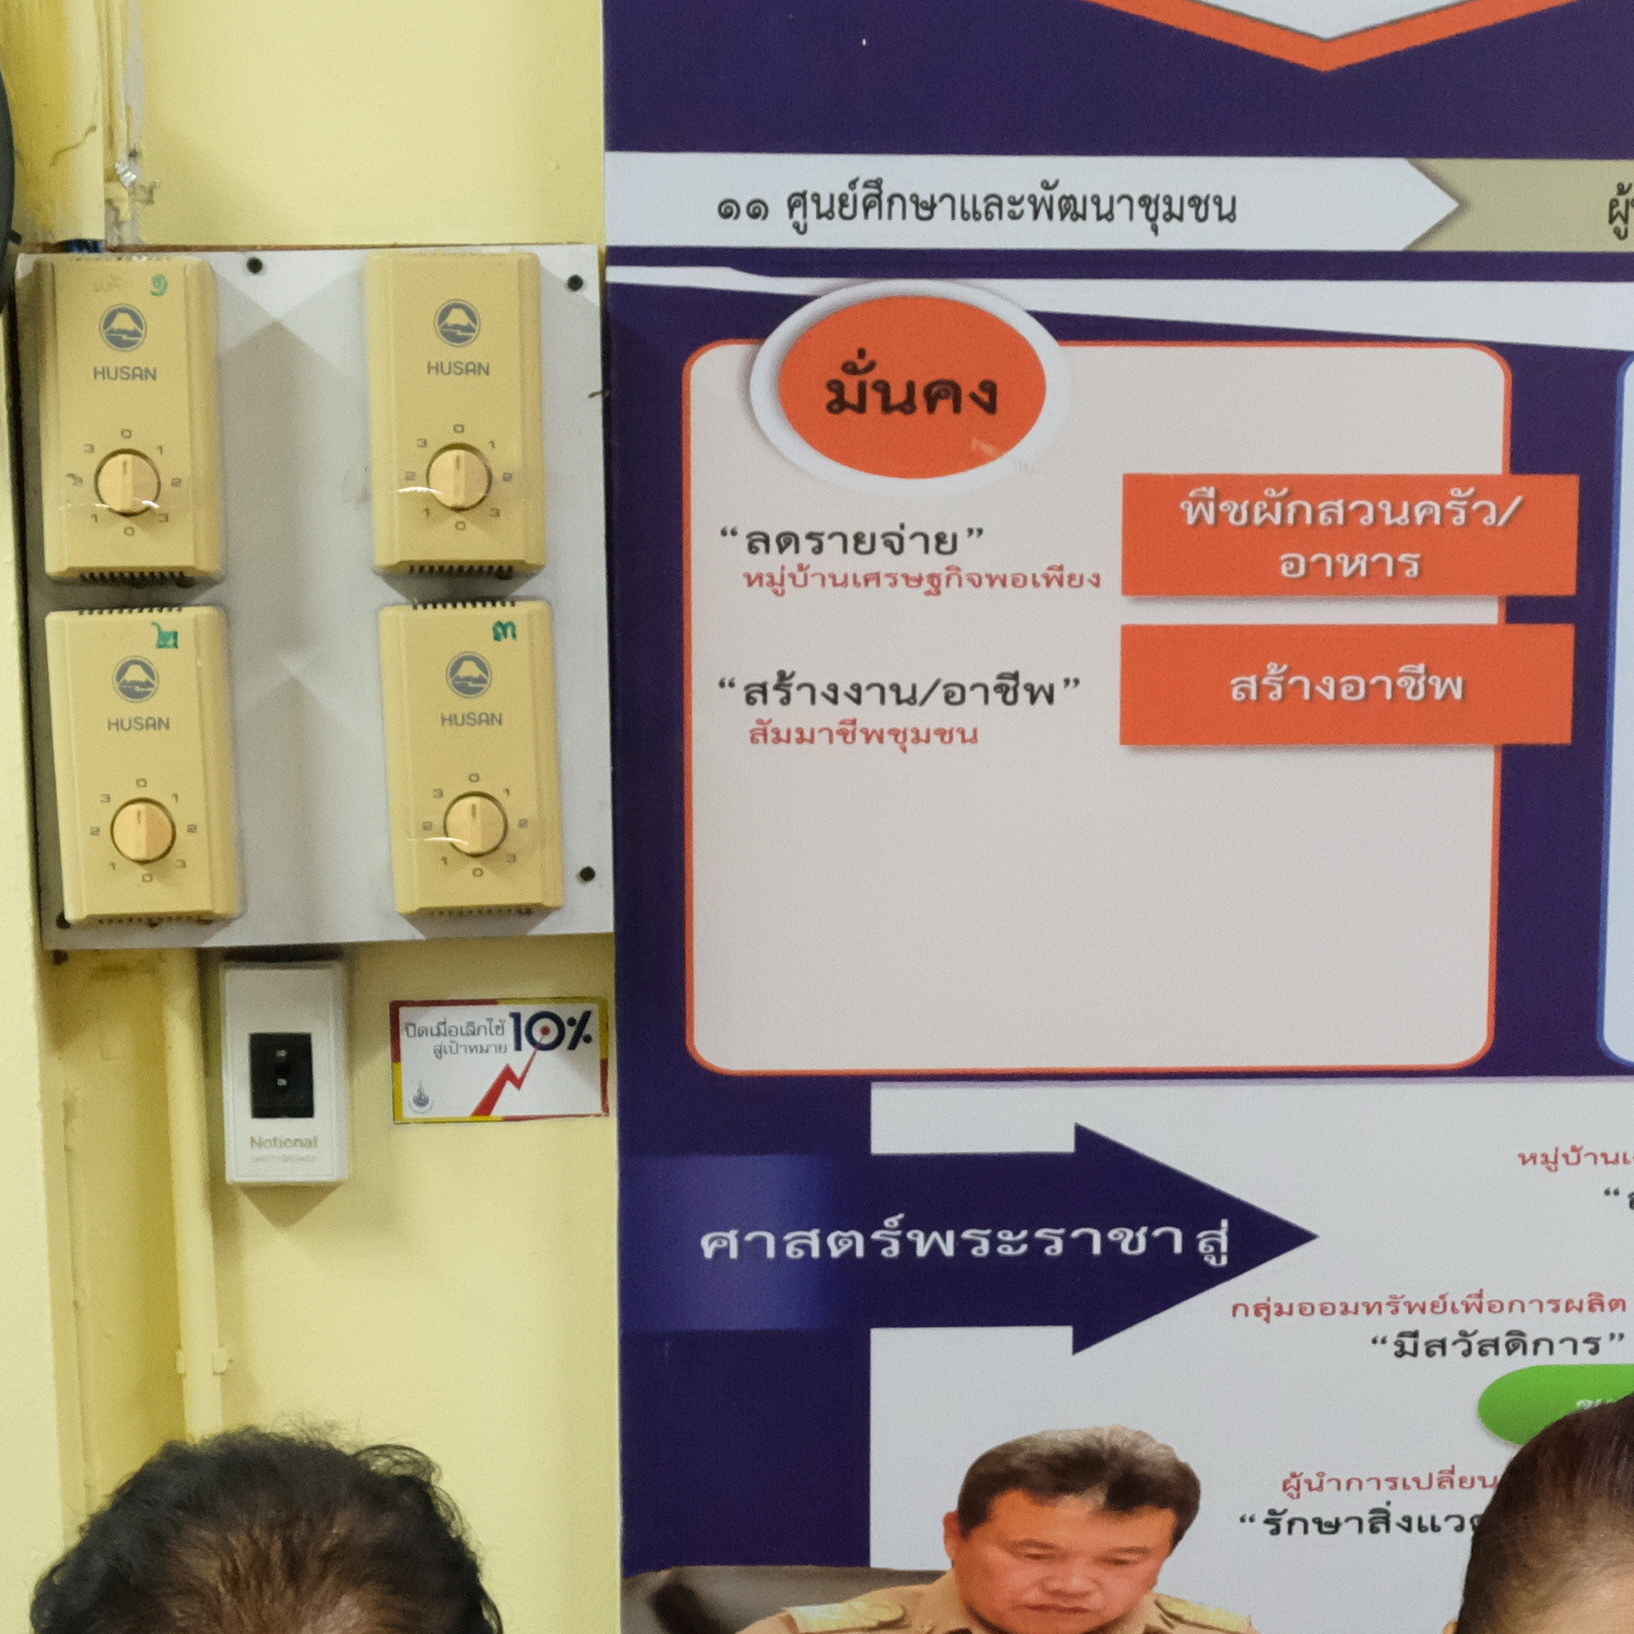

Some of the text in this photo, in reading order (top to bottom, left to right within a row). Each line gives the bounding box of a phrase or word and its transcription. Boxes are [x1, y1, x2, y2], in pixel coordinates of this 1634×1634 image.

[717, 176, 1237, 237] ๑๑ ศูนย์ศึกษาและพัฒนาชุมชน
[93, 365, 158, 382] HUSAN
[426, 360, 490, 377] HUSAN
[826, 347, 1000, 415] มั่นคง
[1179, 486, 1523, 527] พืชผักสวนครัว/
[720, 522, 984, 556] “ลดรายจ่าย”
[742, 562, 1102, 598] หมู่บ้านเศรษฐกิจพอเพียง
[1279, 552, 1422, 579] อาหาร
[718, 669, 1080, 707] “สร้างงาน/อาชีพ”
[1230, 661, 1466, 702] สร้างอาชีพ
[107, 715, 171, 732] HUSAN
[440, 711, 503, 727] HUSAN
[749, 717, 979, 754] สัมมาชีพชุมชน
[508, 1009, 593, 1052] 10%
[699, 1212, 1229, 1267] ศาสตร์พระราชา สู่
[1231, 1288, 1627, 1325] กลุ่มออมทรัพย์เพื่อการผลิต
[1371, 1329, 1625, 1359] “มีสวัสดิการ”
